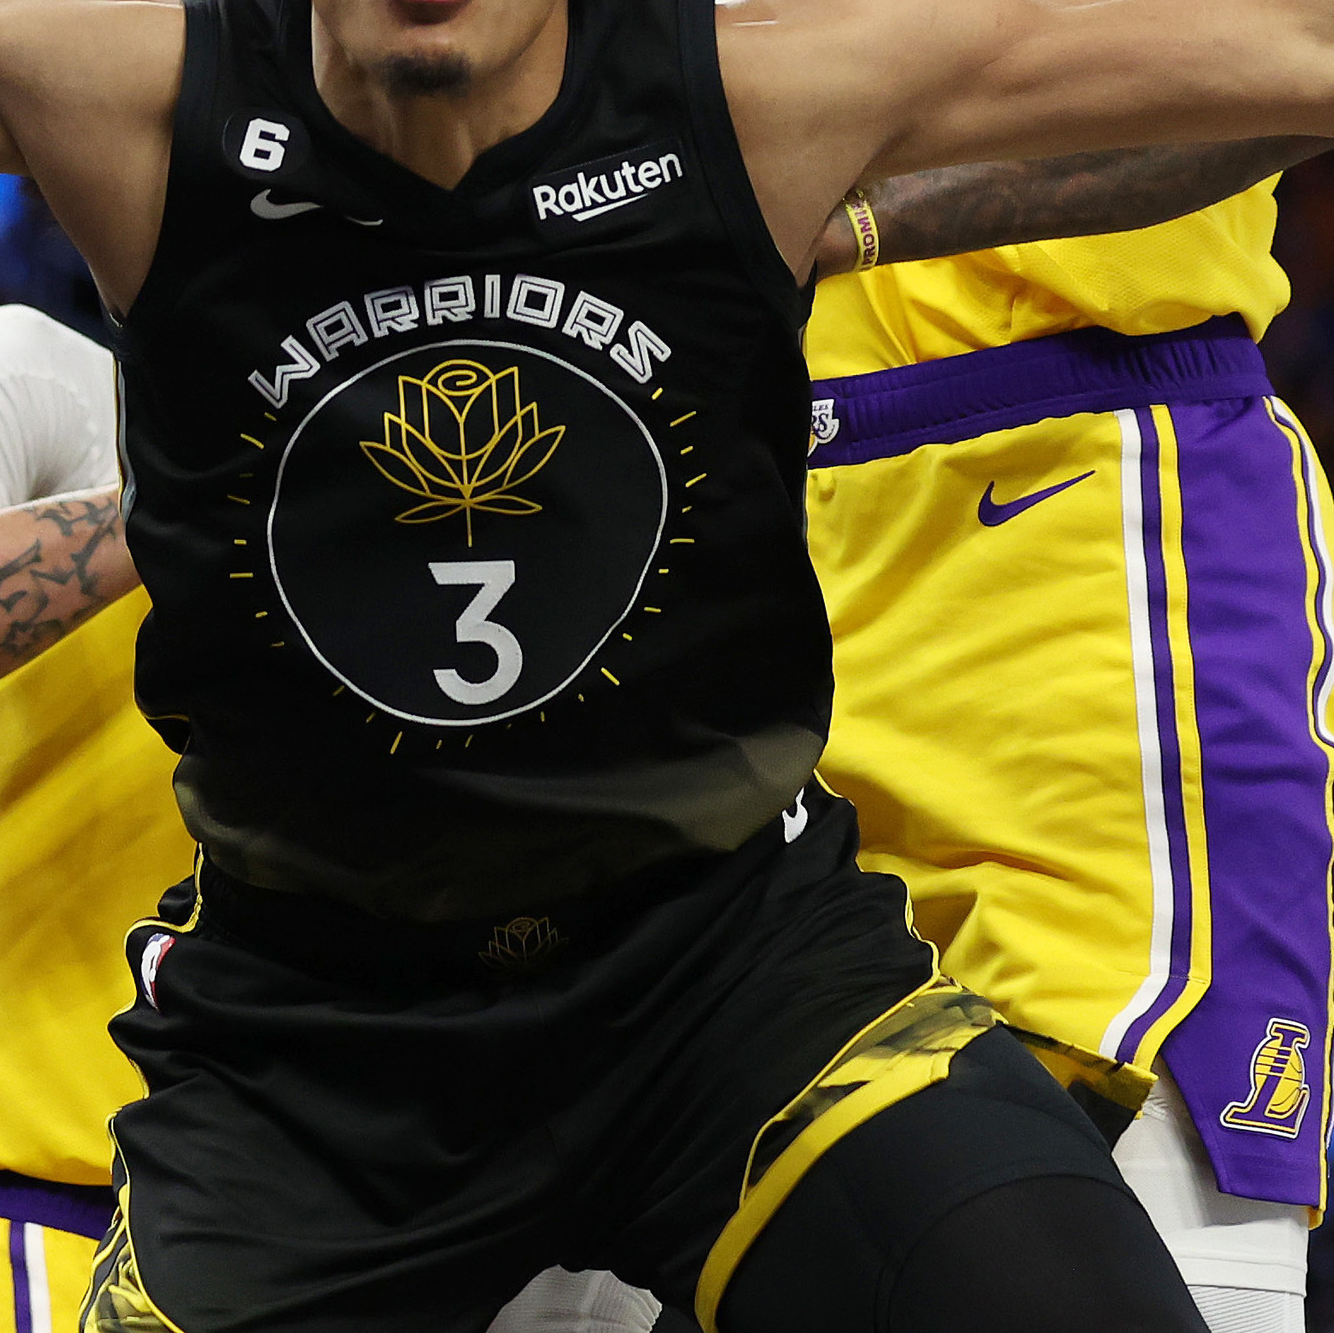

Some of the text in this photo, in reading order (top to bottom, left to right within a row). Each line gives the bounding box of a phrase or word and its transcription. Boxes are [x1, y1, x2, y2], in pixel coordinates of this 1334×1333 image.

[239, 118, 291, 172] 6
[533, 153, 684, 220] Rakuten
[248, 274, 672, 409] WARRIORS
[428, 559, 524, 706] 3
